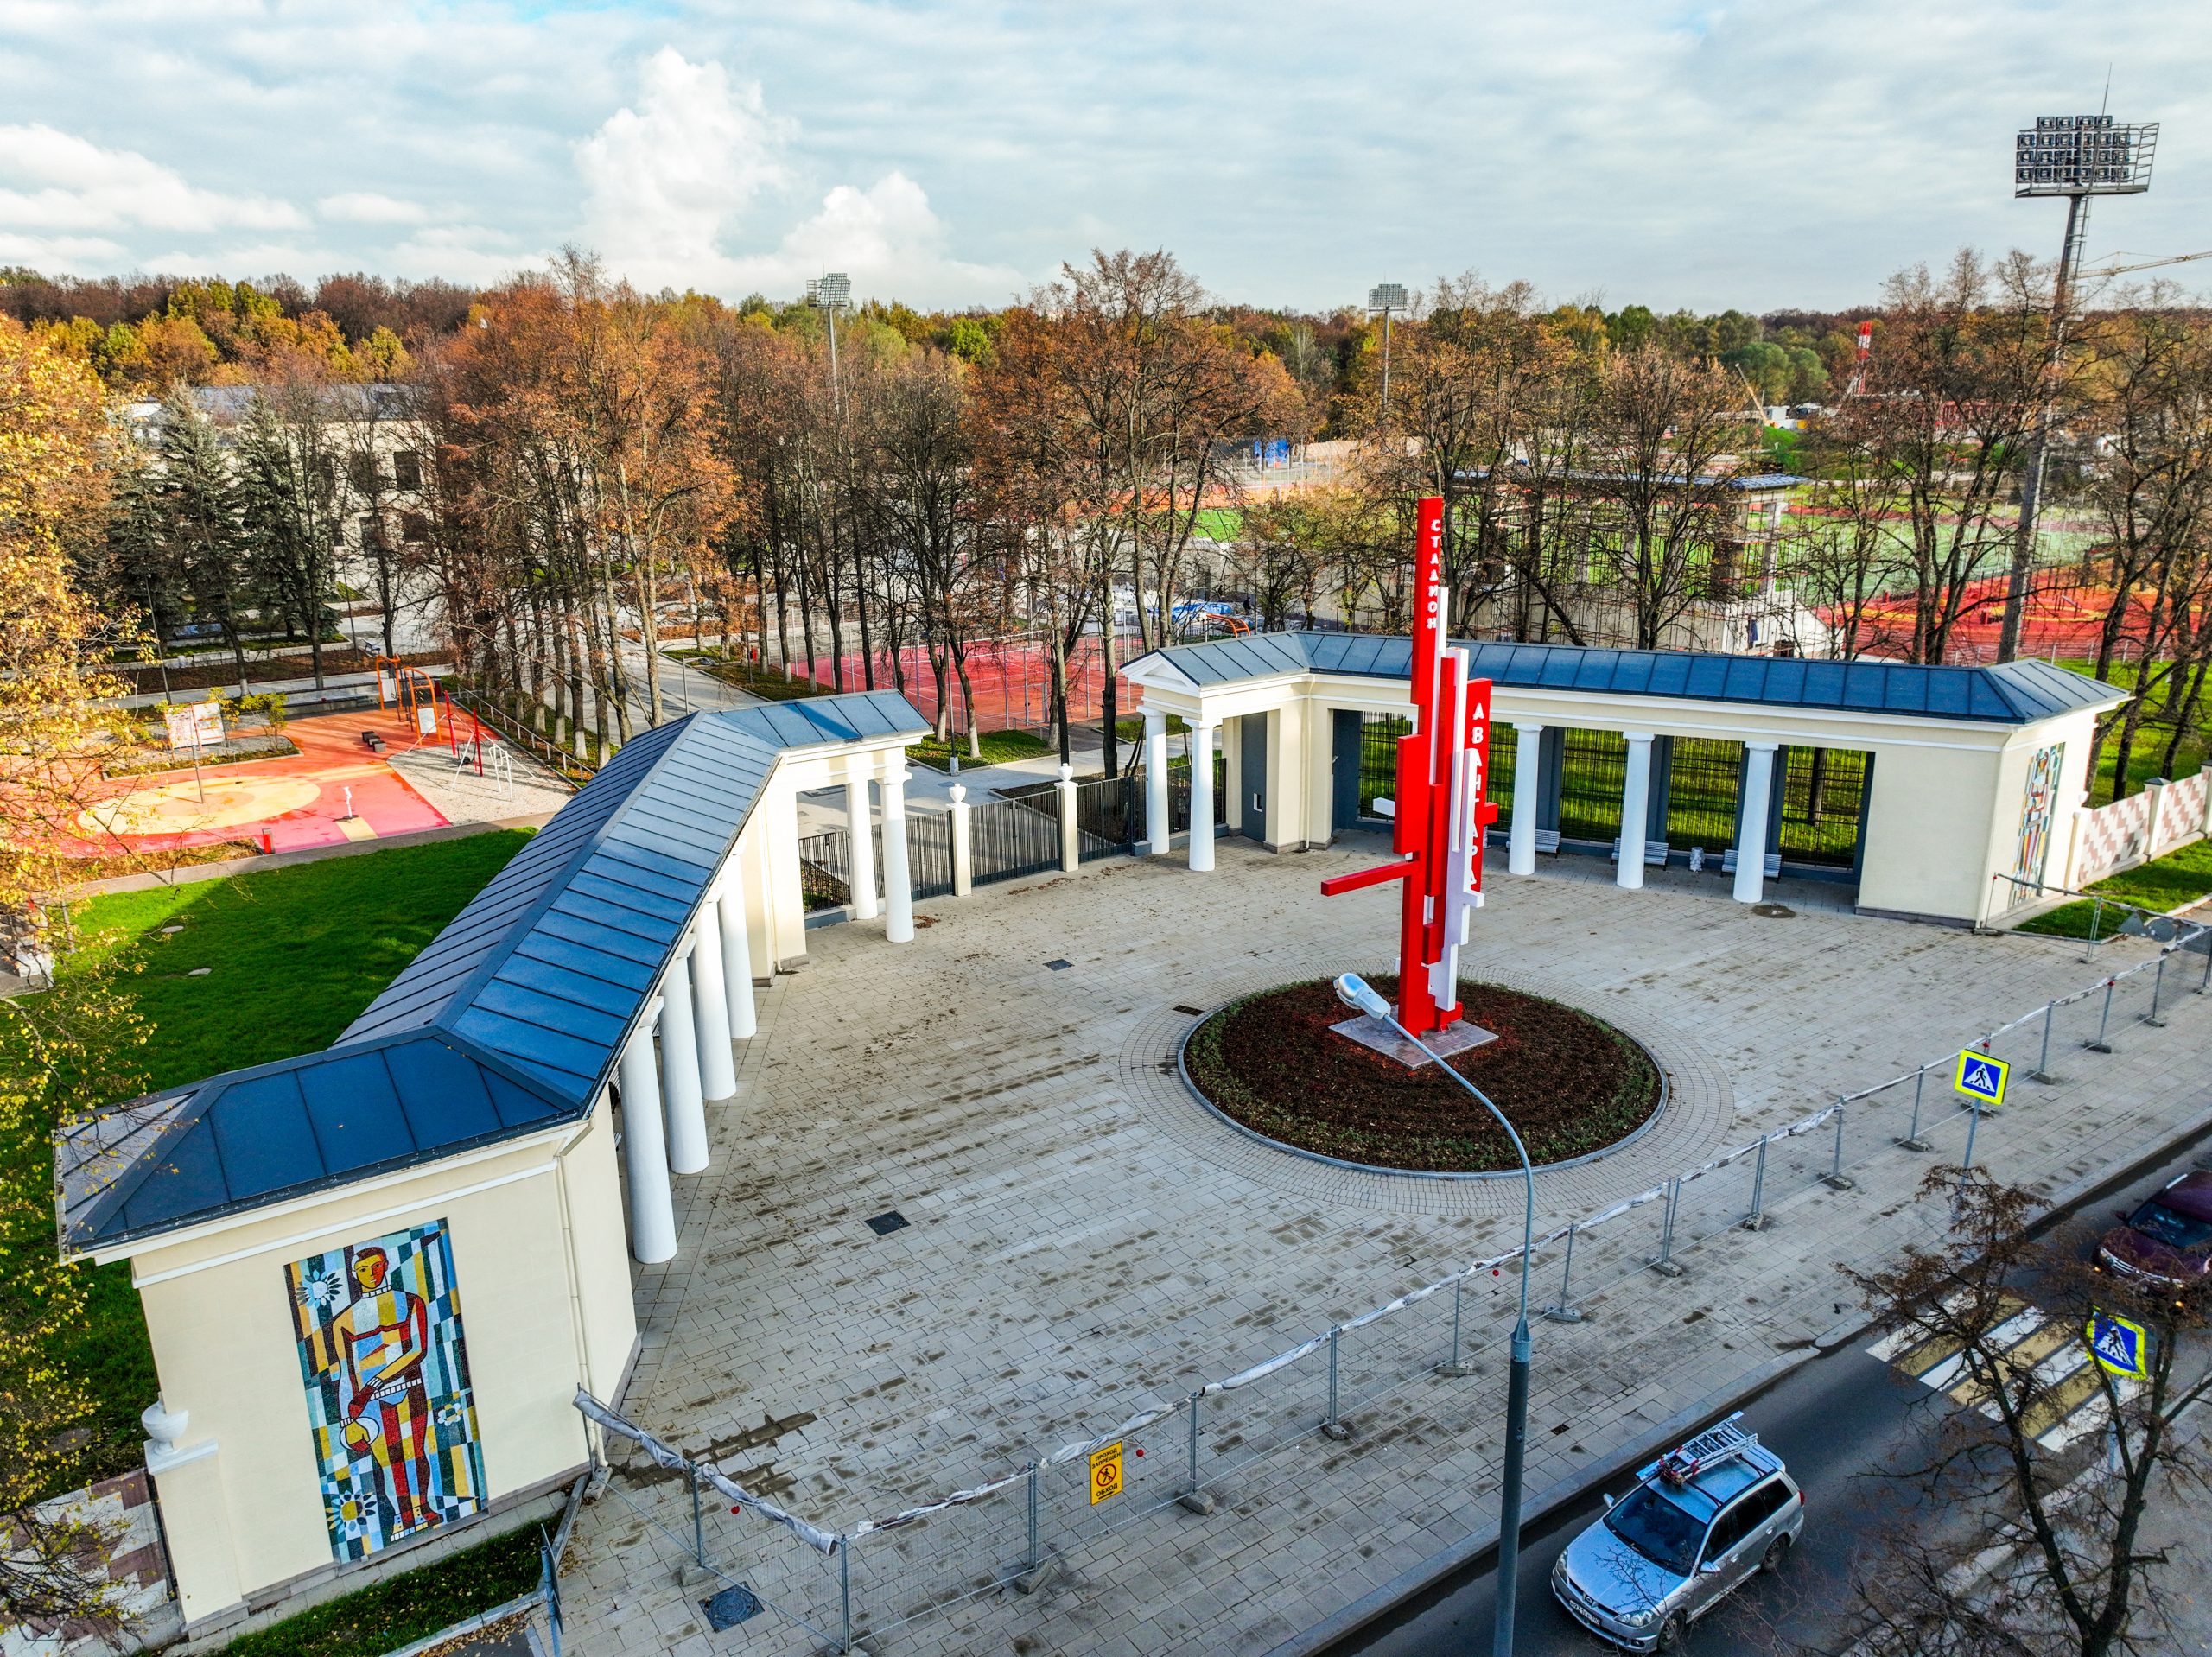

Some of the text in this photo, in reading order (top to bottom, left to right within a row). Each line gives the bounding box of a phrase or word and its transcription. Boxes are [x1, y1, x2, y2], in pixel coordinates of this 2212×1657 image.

[1427, 518, 1441, 630] СТАДИОН
[1091, 1451, 1121, 1470] ЗАПРЕЩЕН
[1095, 1447, 1117, 1461] ПРОХОД
[1096, 1482, 1118, 1497] ОБХОД
